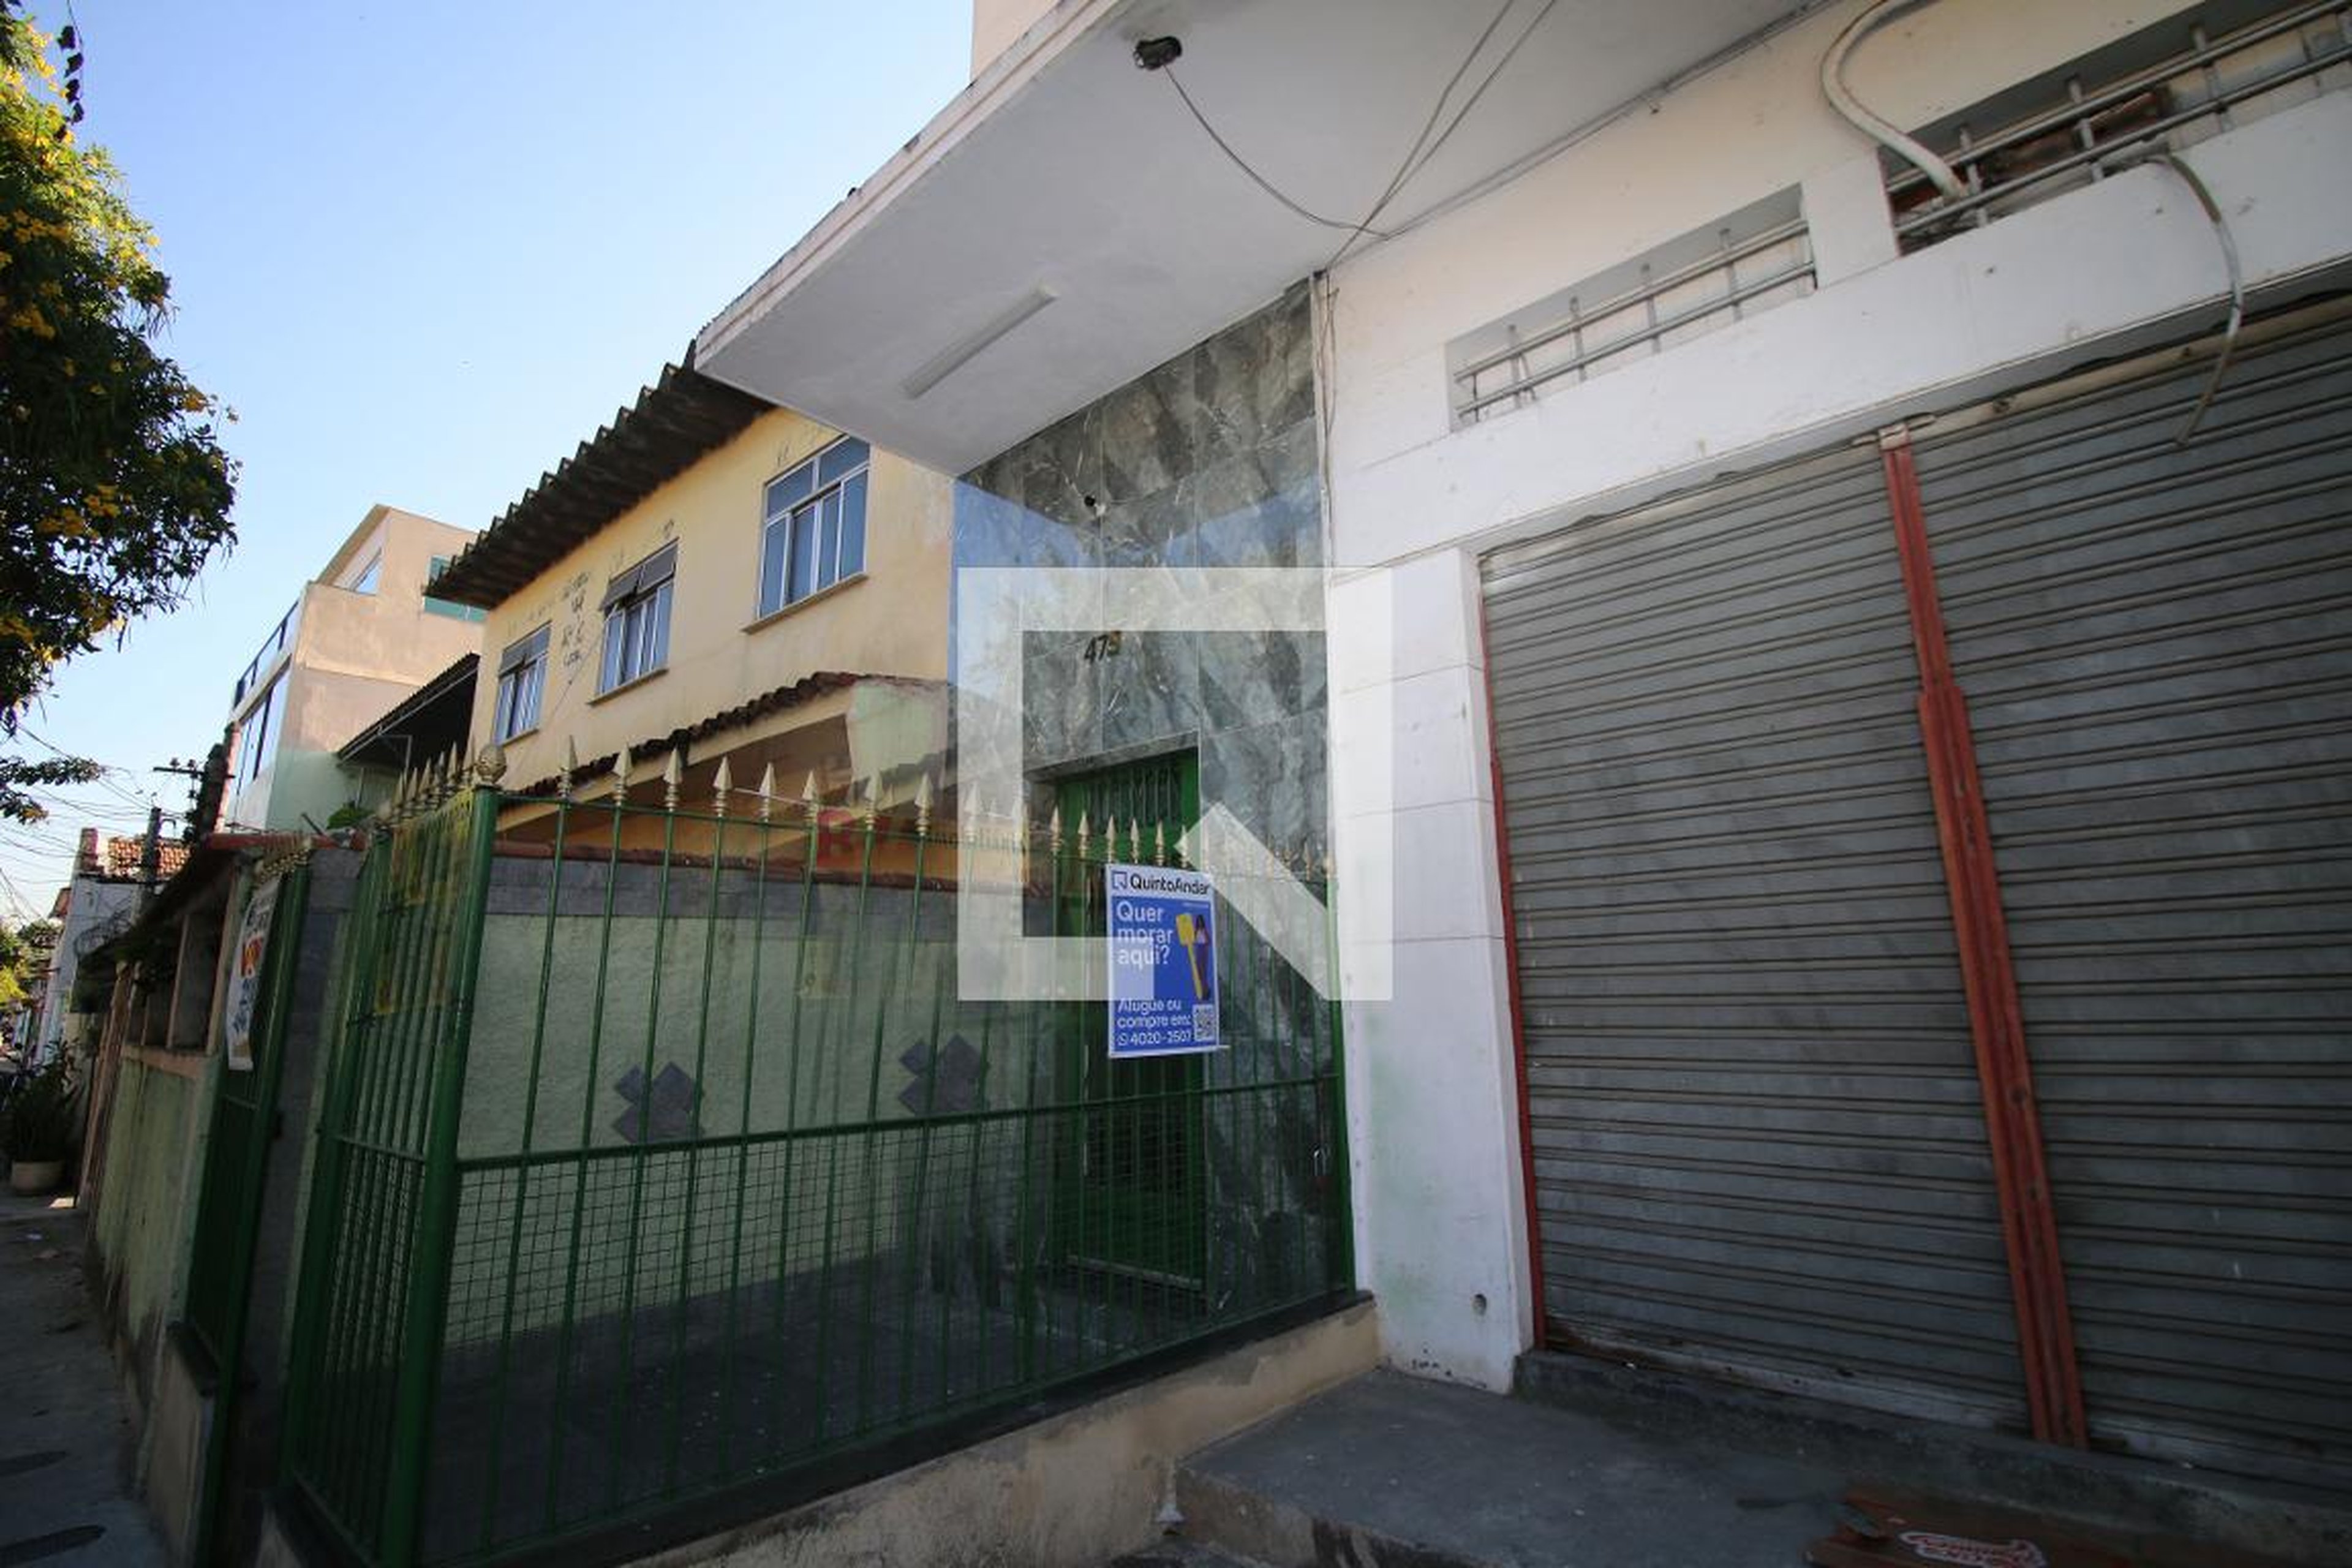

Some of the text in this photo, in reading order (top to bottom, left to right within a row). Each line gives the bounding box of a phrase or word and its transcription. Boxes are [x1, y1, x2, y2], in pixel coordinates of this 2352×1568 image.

[1130, 873, 1210, 894] QuintoAndar
[1117, 900, 1163, 922] Quer
[1118, 928, 1173, 944] morar
[1118, 945, 1170, 970] aqui?
[1118, 998, 1181, 1015] Alugue ou
[1117, 1016, 1169, 1029] compra
